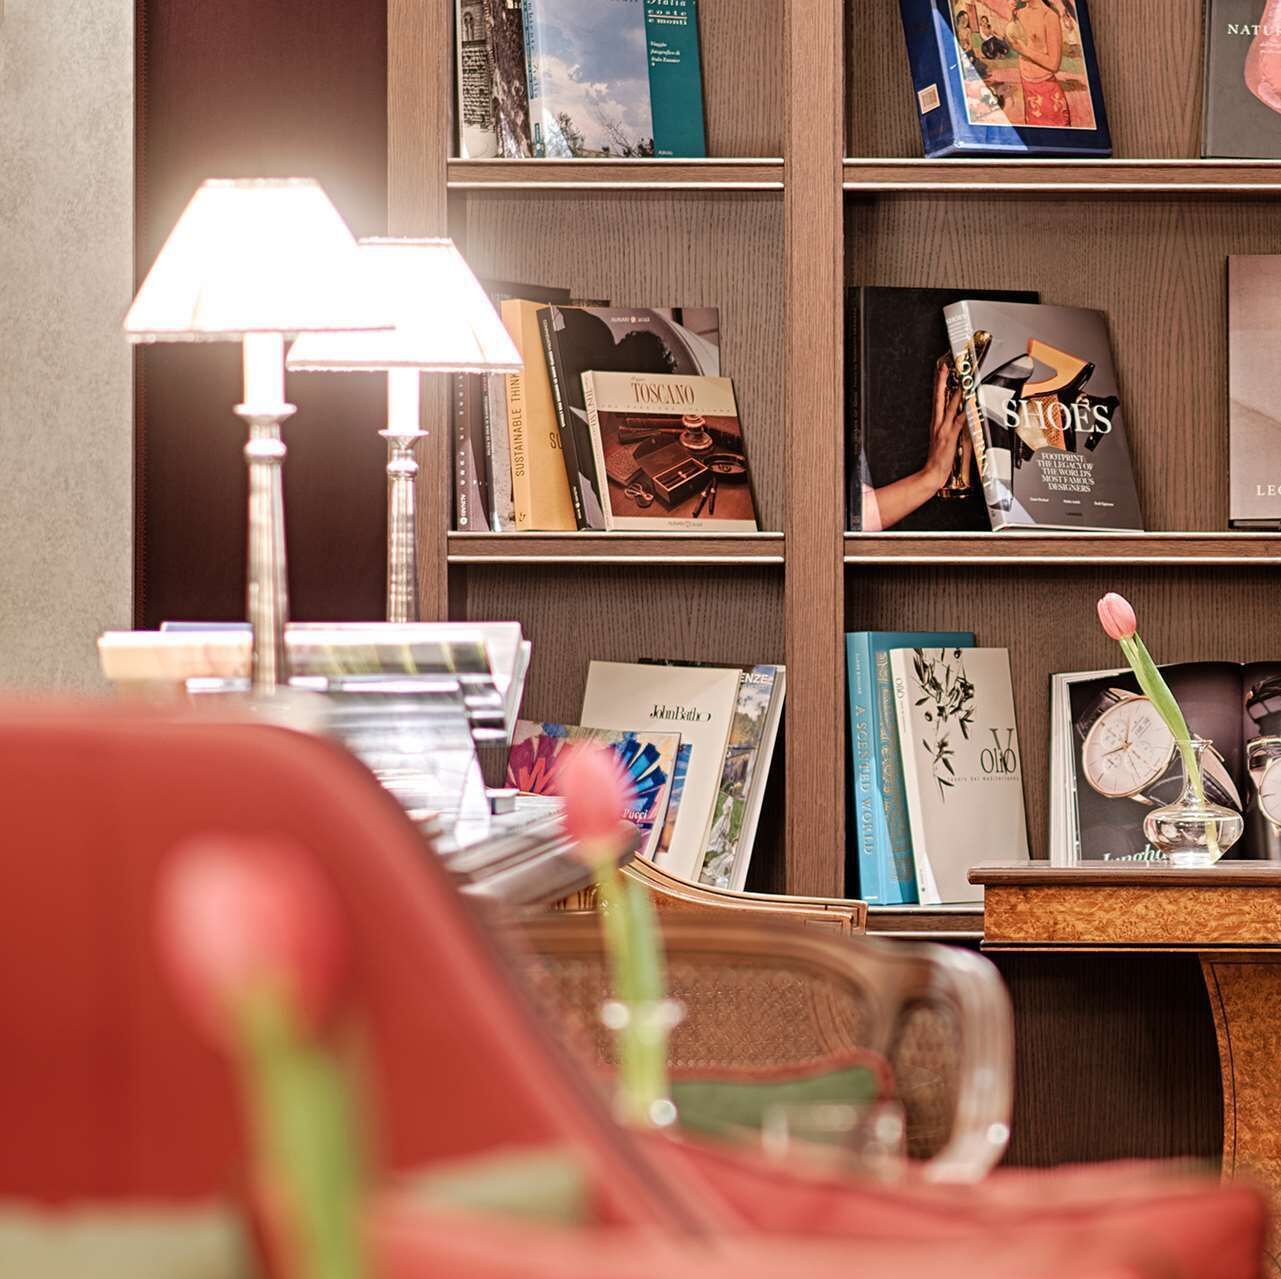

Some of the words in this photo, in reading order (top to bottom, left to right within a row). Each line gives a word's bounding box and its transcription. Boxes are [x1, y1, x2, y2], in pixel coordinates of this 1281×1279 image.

[631, 382, 695, 404] TOSCANO
[1001, 396, 1113, 435] SHOES
[512, 408, 525, 477] SUSTAINABLE
[740, 671, 769, 685] ENZE
[855, 703, 864, 717] A
[857, 721, 872, 794] SCENTED
[860, 798, 873, 857] WORLD
